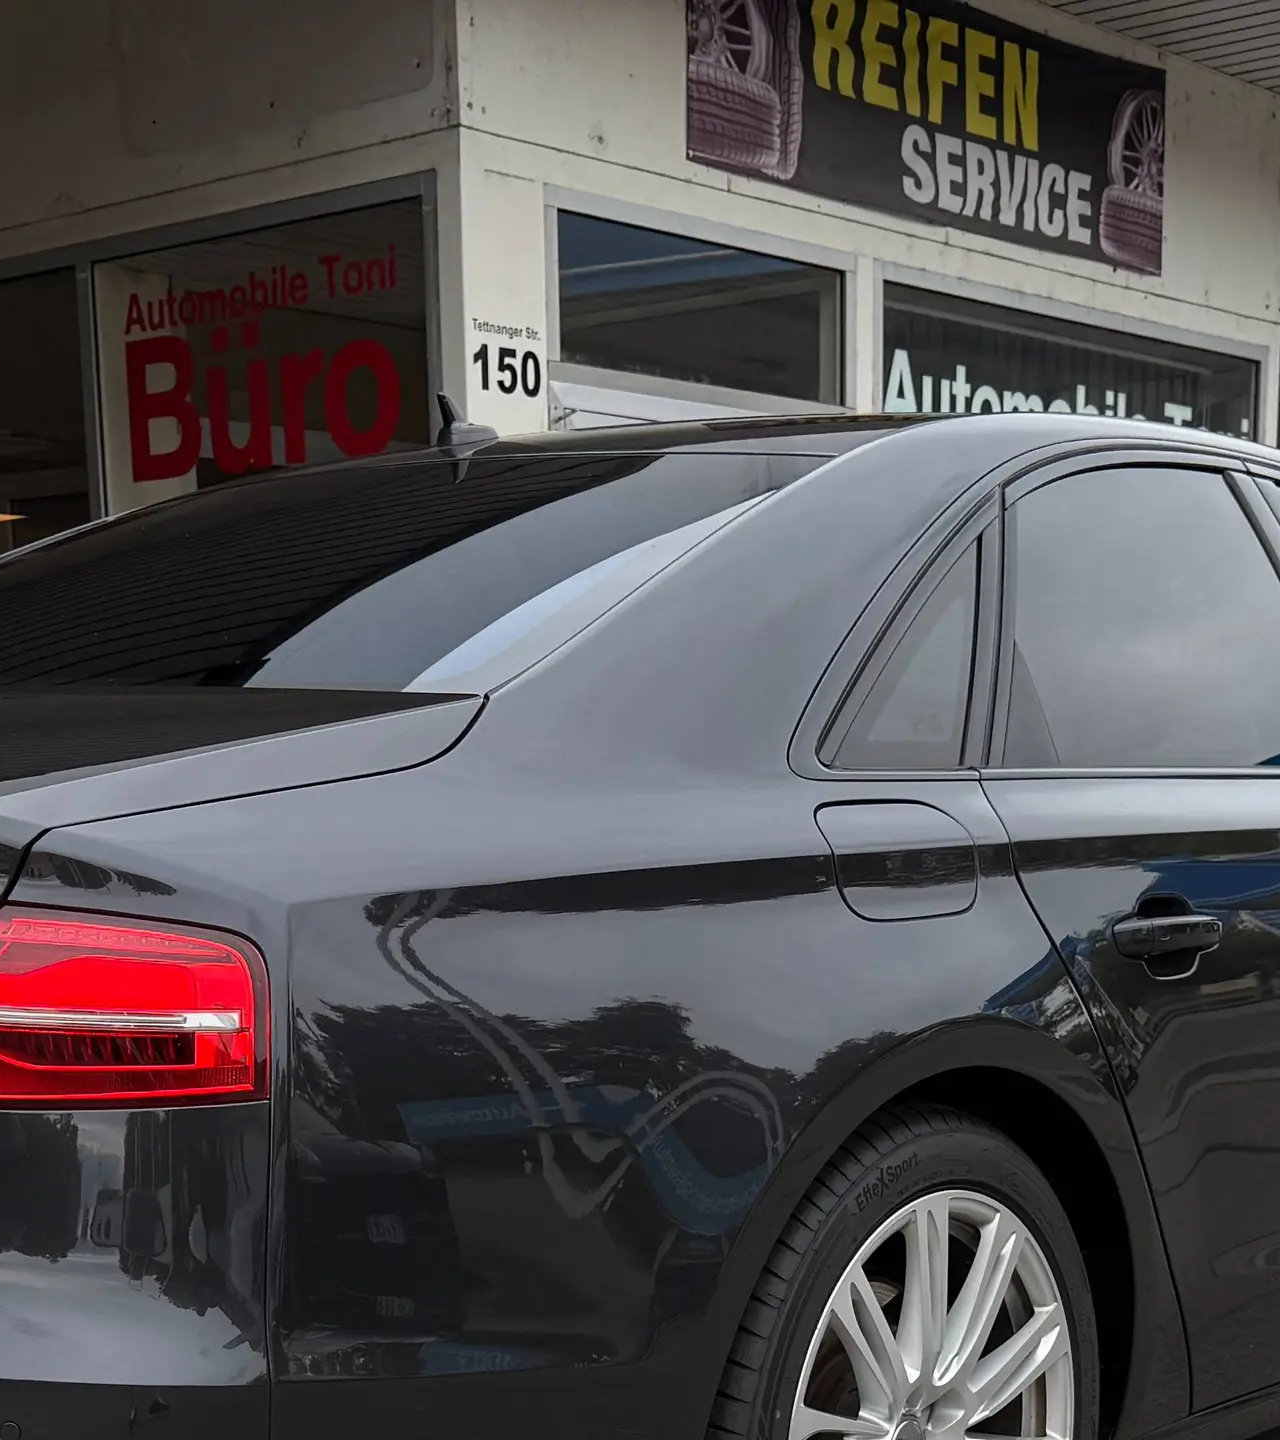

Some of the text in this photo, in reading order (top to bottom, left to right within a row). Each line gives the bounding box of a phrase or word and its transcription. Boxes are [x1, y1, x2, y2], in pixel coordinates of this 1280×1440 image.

[811, 0, 1040, 151] REIFEN
[901, 124, 1092, 245] SERVICE
[124, 243, 397, 336] Automobile Toni
[472, 317, 541, 341] Tettnanger Str.
[125, 321, 402, 483] Büro
[473, 343, 541, 398] 150
